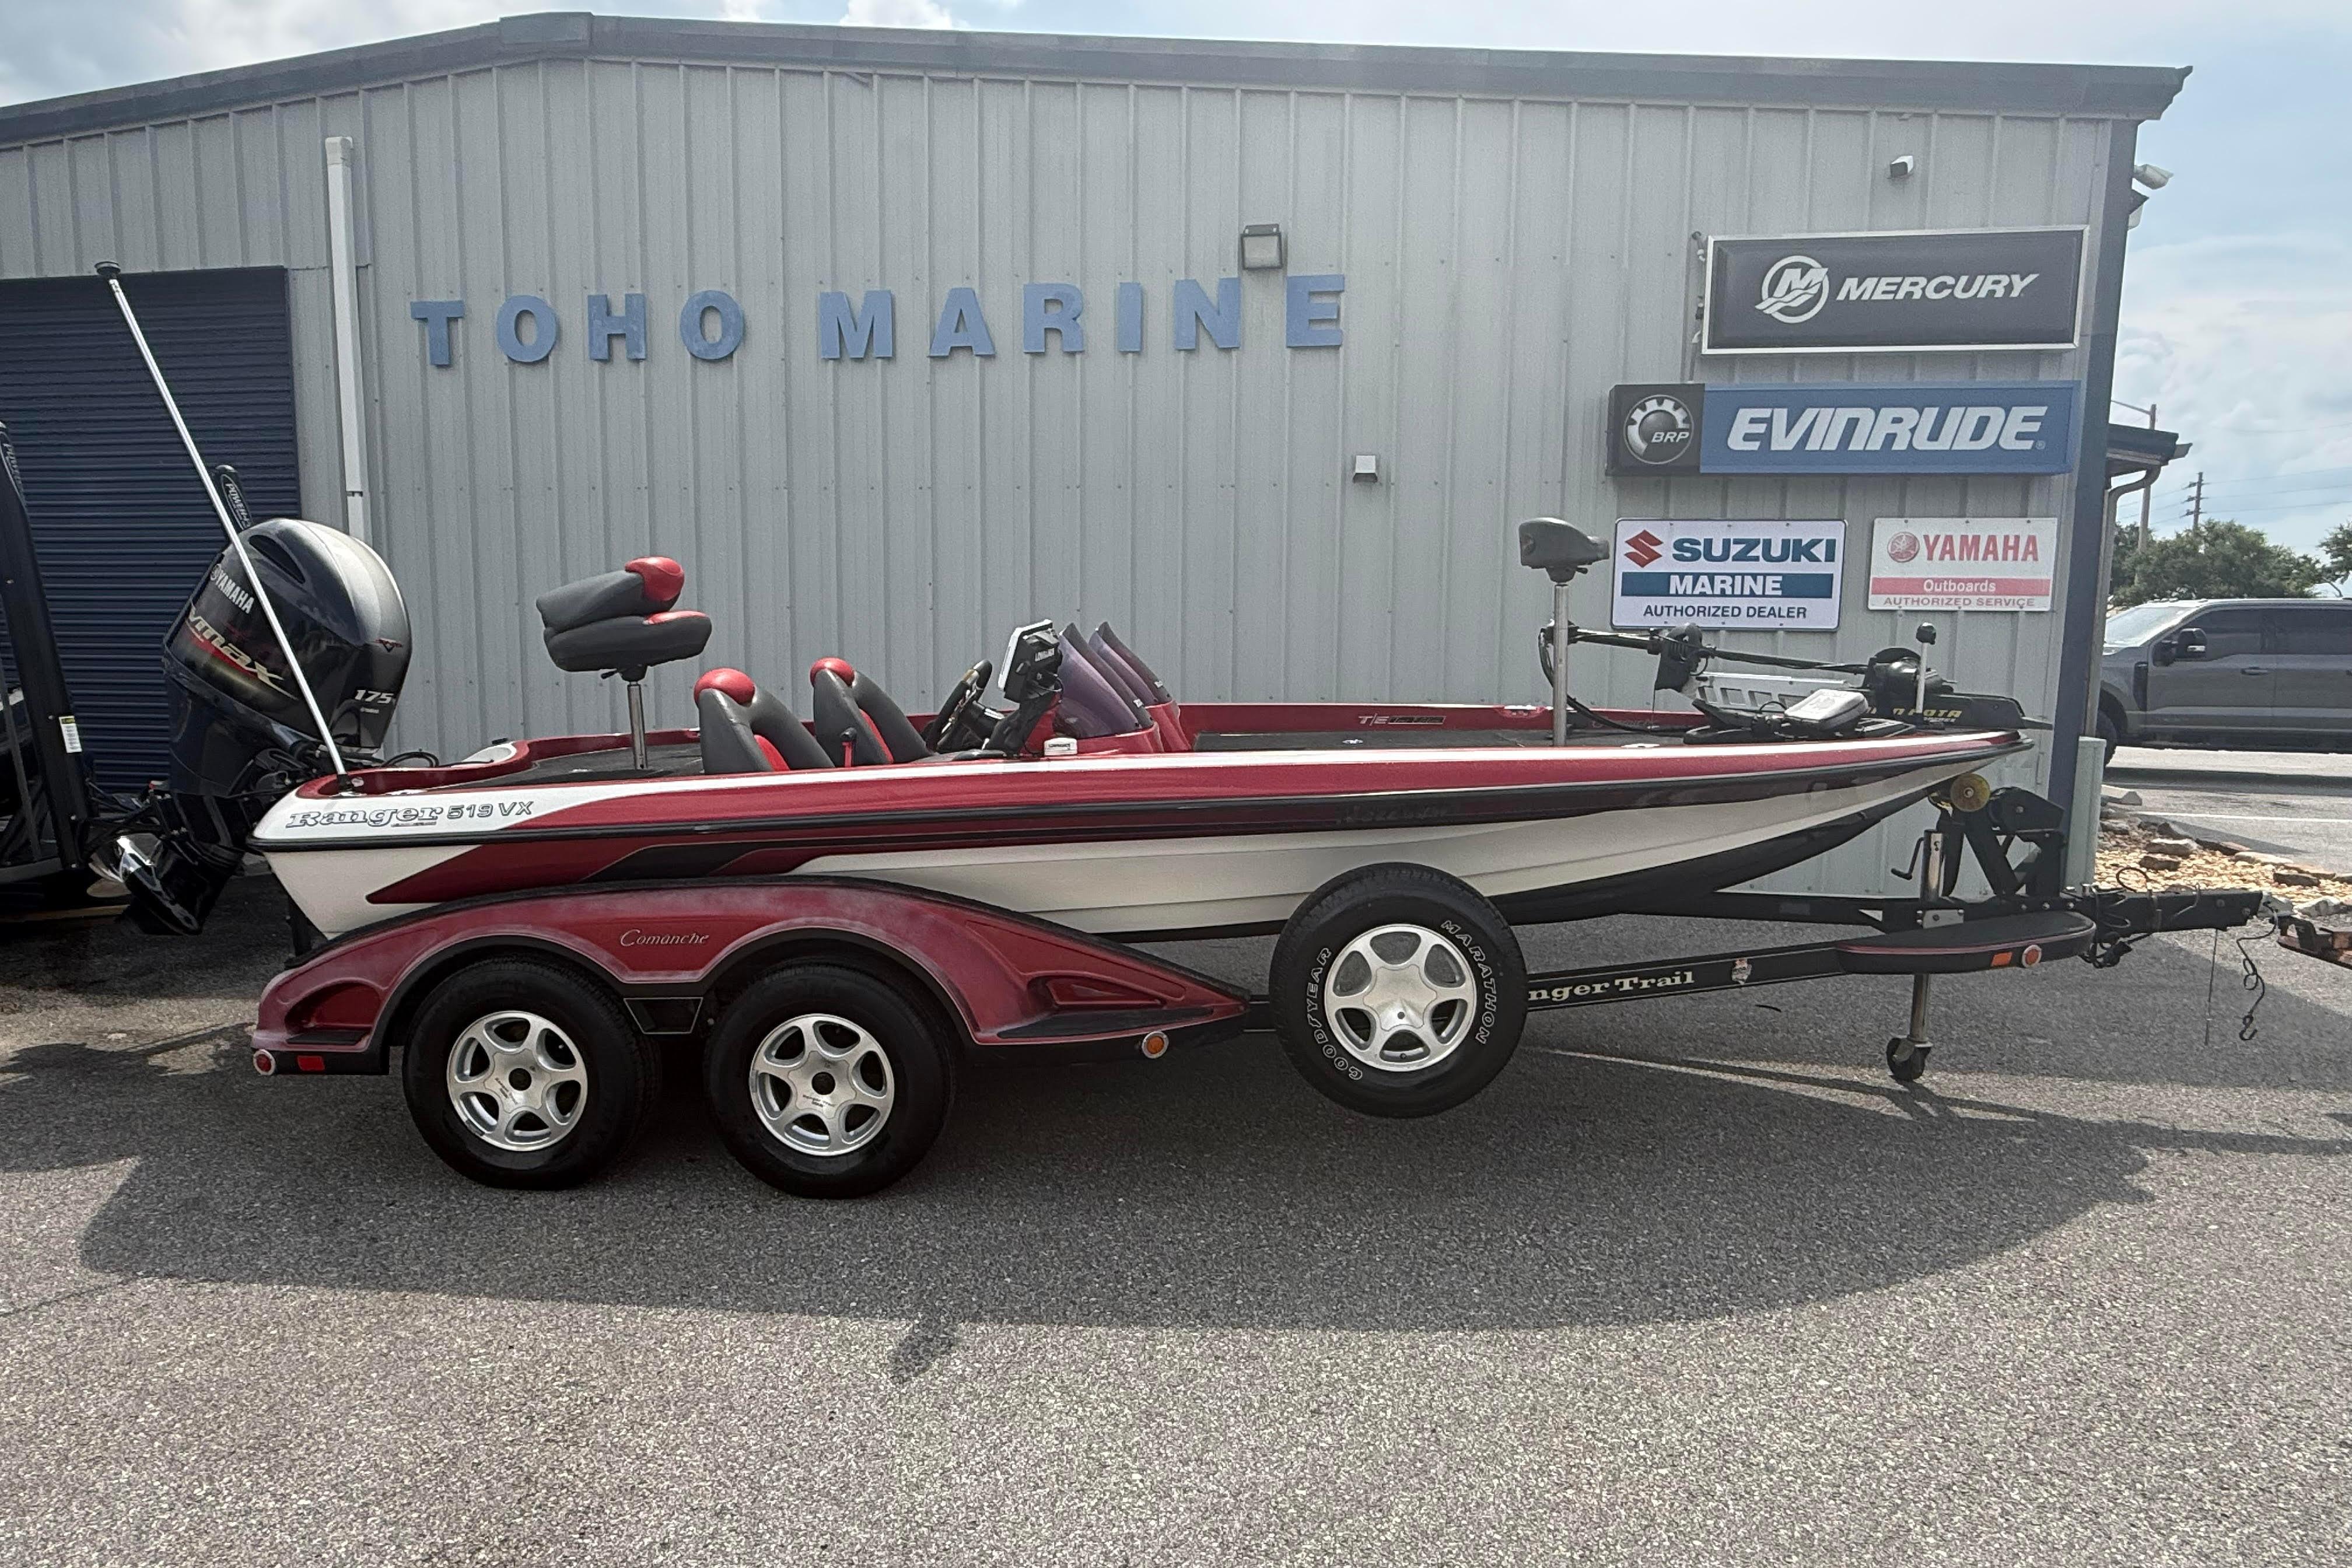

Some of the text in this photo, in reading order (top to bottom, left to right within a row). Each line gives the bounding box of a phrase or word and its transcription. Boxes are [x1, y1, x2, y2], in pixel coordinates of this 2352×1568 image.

[1836, 273, 2040, 301] MERCURY
[410, 274, 1346, 366] TOHO MARINE
[1651, 431, 1690, 443] BRP
[1727, 406, 2048, 451] EVINRUDE
[1672, 538, 1836, 562] SUZUKI
[1923, 534, 2039, 561] YAMAHA
[215, 572, 255, 614] YAMAHA
[1670, 575, 1783, 596] MARINE
[1924, 579, 1996, 592] Outboards
[1643, 604, 1807, 619] AUTHORIZED DEALER
[1884, 597, 2035, 607] AUTHORIZED SERVICE
[355, 690, 394, 704] 175
[285, 801, 535, 828] Ranger 519 VX
[620, 929, 710, 946] Comanche
[1440, 919, 1497, 1044] MARATHON
[1528, 971, 1695, 1002] nger Trail
[1306, 947, 1363, 1080] GOODYEAR
